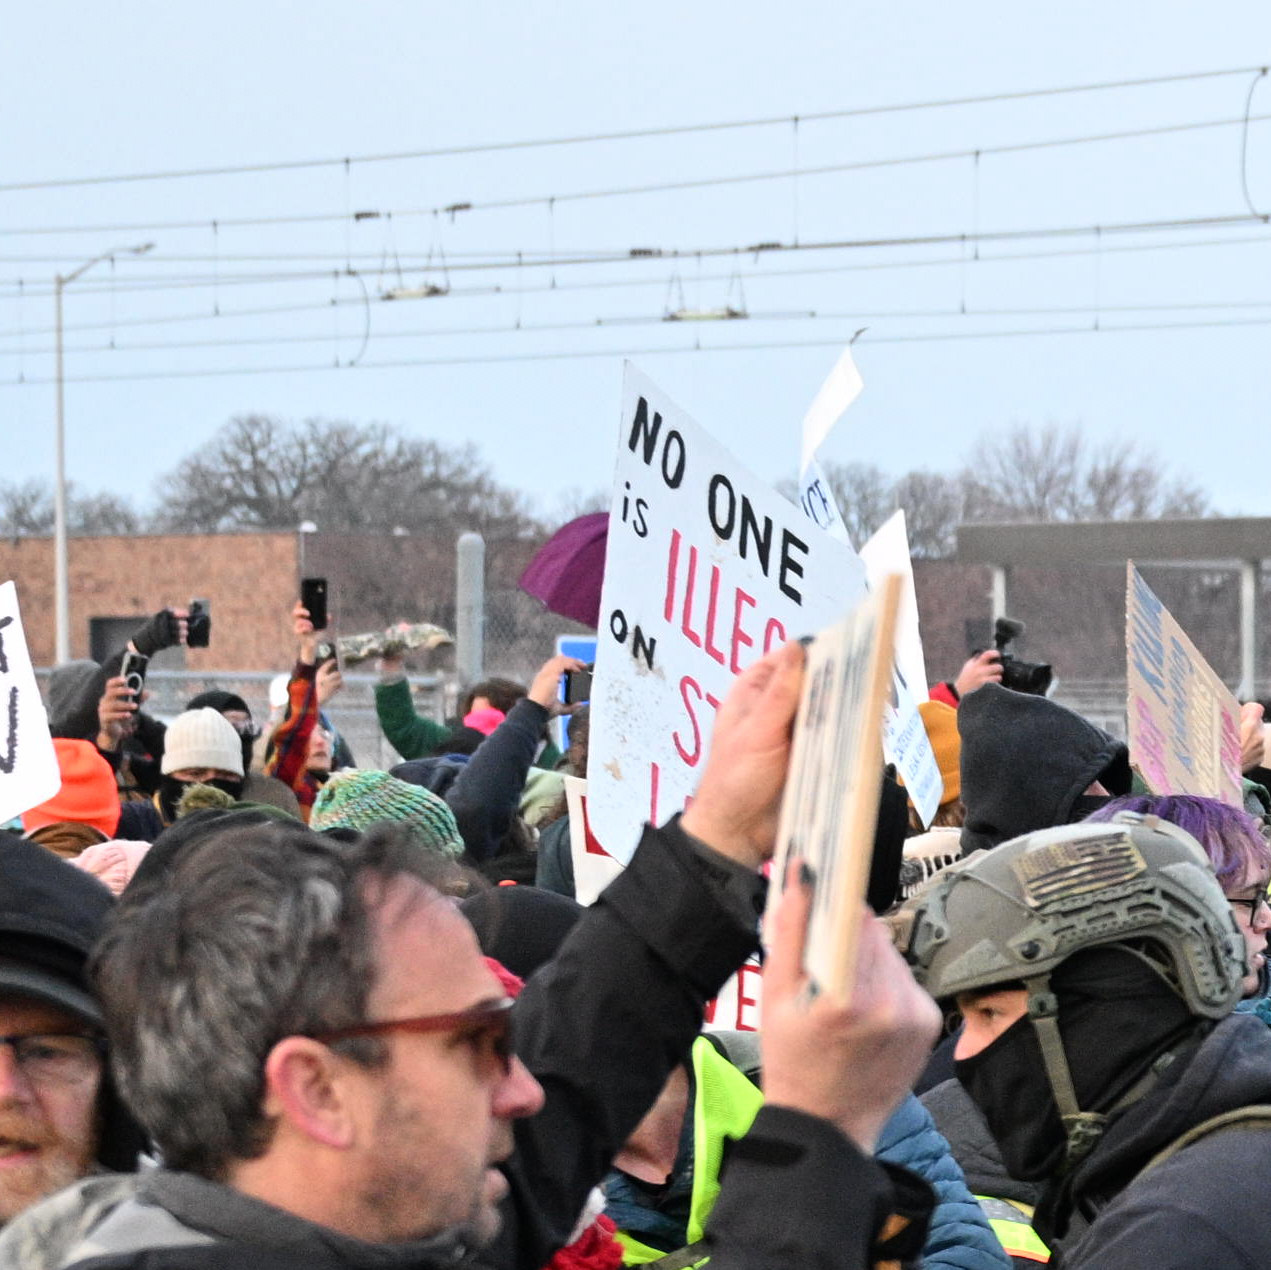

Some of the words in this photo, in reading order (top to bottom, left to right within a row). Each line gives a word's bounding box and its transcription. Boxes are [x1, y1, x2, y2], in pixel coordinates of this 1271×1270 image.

[628, 396, 687, 490] NO
[708, 473, 810, 607] ONE
[610, 609, 657, 671] ON
